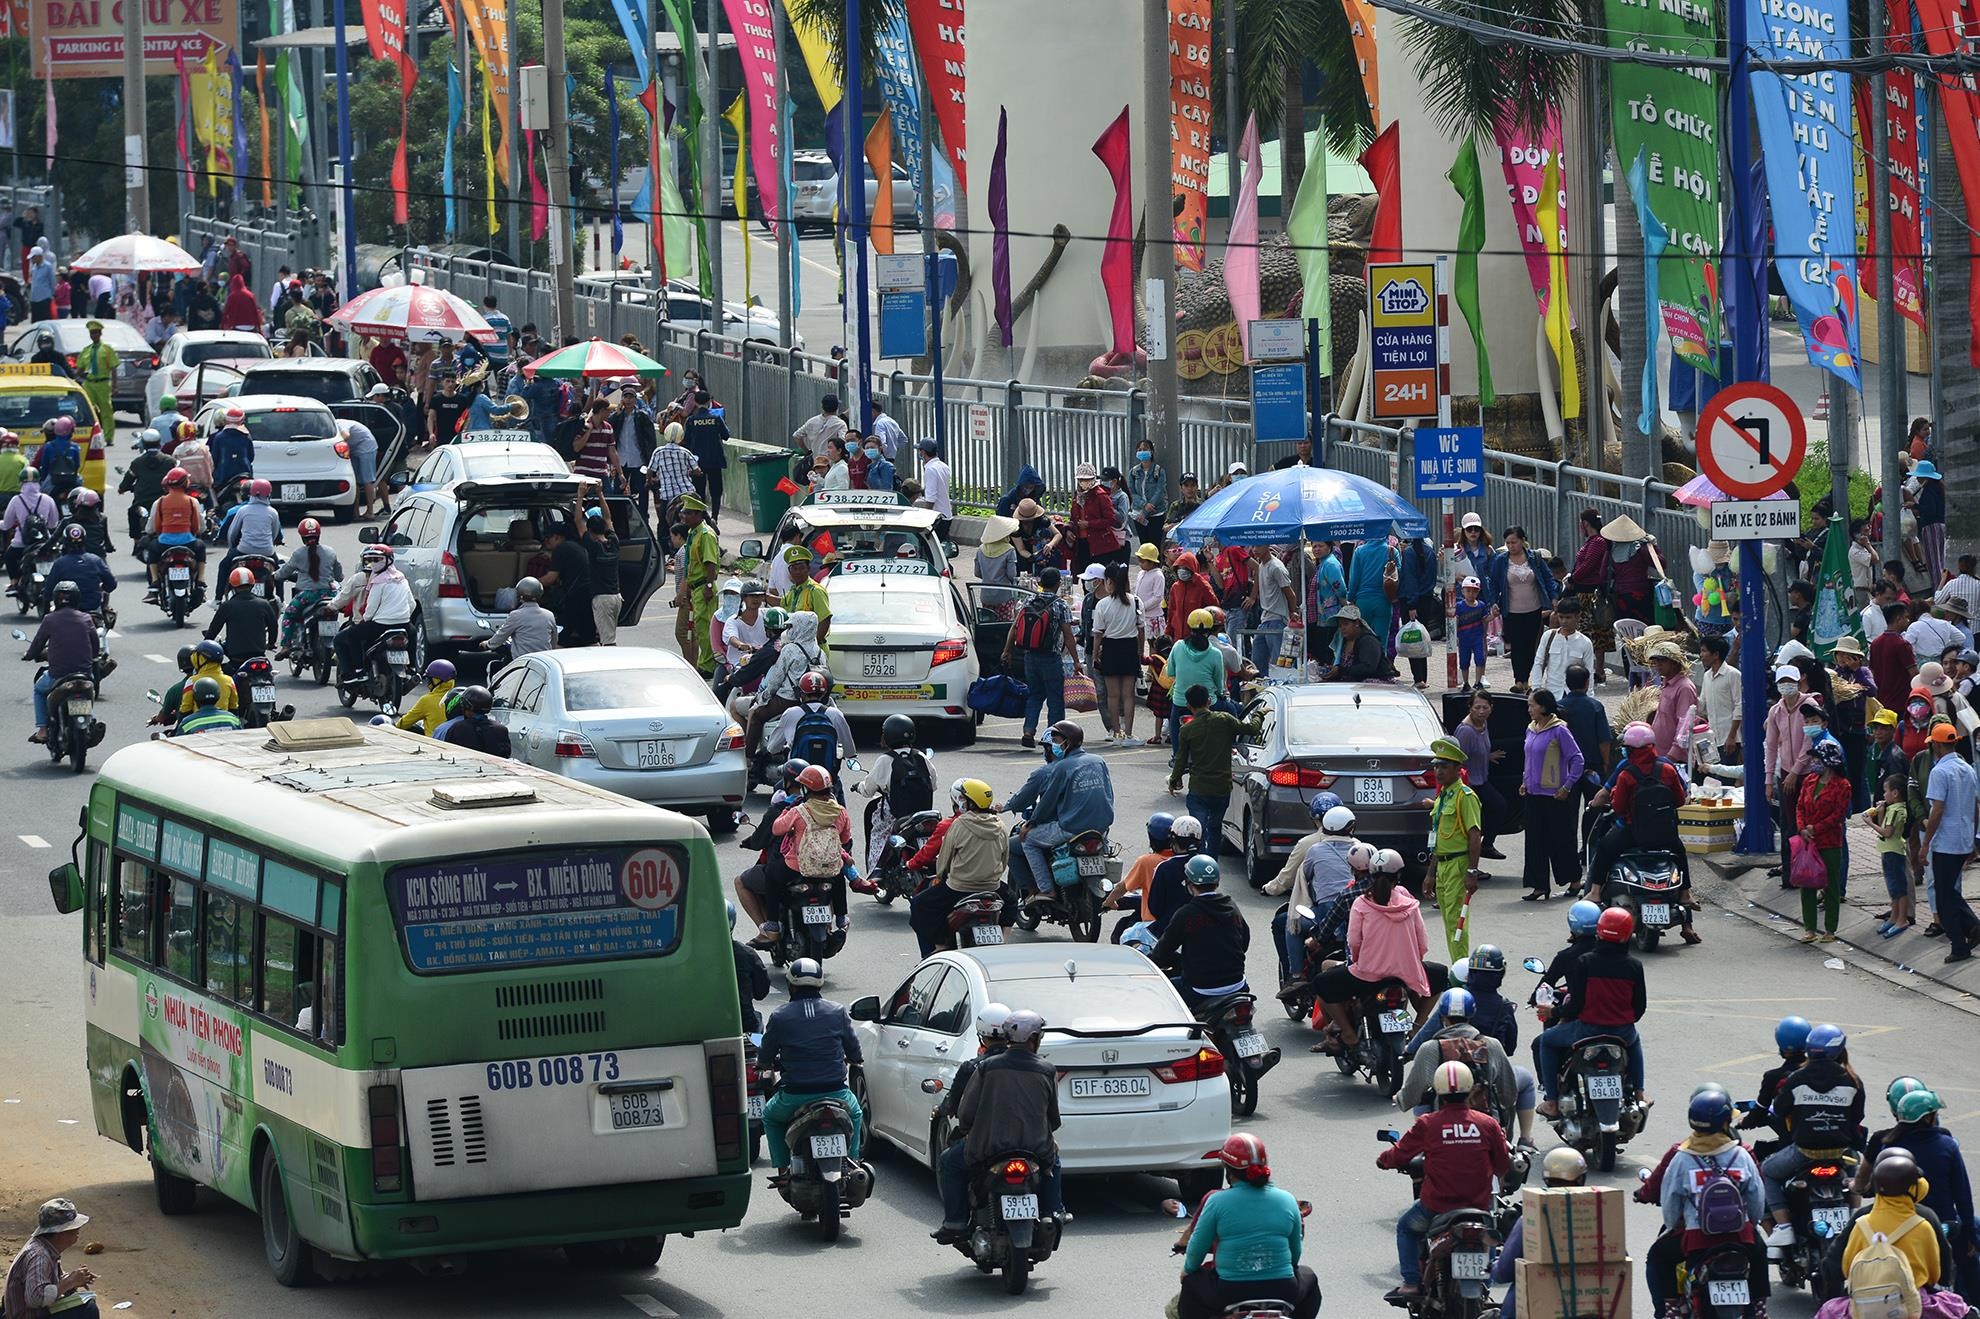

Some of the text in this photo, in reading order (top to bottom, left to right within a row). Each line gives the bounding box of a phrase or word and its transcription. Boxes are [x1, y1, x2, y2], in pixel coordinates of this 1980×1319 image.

[56, 41, 111, 54] PARKING
[1627, 93, 1659, 124] TỔ
[1673, 166, 1711, 203] HỘI
[1388, 288, 1417, 299] MINI
[1388, 299, 1419, 310] STOP
[1376, 331, 1433, 346] CỬA HÀNG
[1382, 350, 1428, 364] TIỆN LỢI
[1384, 383, 1427, 401] 24H
[505, 434, 516, 442] 27
[518, 434, 529, 442] 27
[1439, 433, 1460, 453] WC
[1421, 457, 1477, 476] NHÀ VỆ SINH
[834, 496, 895, 504] 38.27 27 27
[1715, 509, 1797, 528] CẤM XE 02 BÁNH
[862, 564, 926, 574] 38.27 27 27
[870, 655, 889, 664] 51F
[863, 665, 895, 675] 579.26
[856, 690, 869, 700] 30
[647, 743, 667, 755] 51A
[640, 755, 675, 768] 700.66
[1363, 779, 1384, 790] 63A
[1356, 791, 1391, 803] 083.30
[406, 858, 614, 907] KCN SÔNG MÂY BX. MIỀN ĐÔNG
[629, 860, 675, 899] 604
[164, 994, 243, 1057] NHỰA TIỀN PHONG
[486, 1059, 533, 1091] 60B
[588, 1052, 620, 1081] 73
[1074, 1079, 1147, 1096] 51F-636.04
[1591, 1087, 1621, 1098] 094.08
[622, 1094, 649, 1109] 60B
[1802, 1094, 1848, 1104] SWAROVSKI
[614, 1109, 662, 1127] 008.73
[1442, 1123, 1481, 1138] FILA
[816, 1136, 841, 1147] 55-X1
[817, 1146, 842, 1157] 6246
[1007, 1196, 1032, 1207] 59-C1
[1004, 1207, 1037, 1219] 274.12
[1457, 1254, 1484, 1265] 47-L6
[1715, 1281, 1742, 1292] 15-K1
[1713, 1292, 1747, 1303] 041.17
